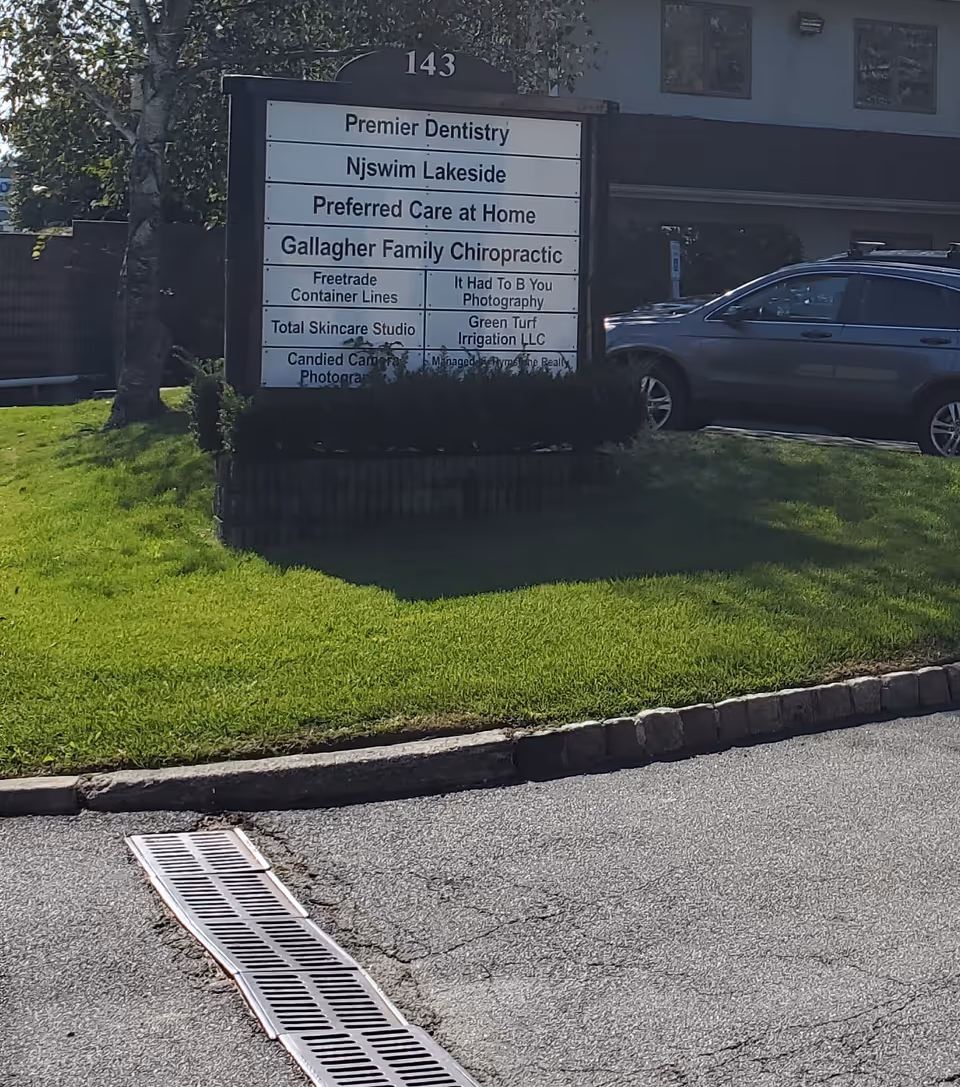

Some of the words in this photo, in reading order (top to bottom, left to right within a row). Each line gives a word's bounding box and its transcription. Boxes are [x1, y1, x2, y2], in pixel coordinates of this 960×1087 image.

[405, 51, 456, 76] 143
[346, 114, 419, 135] Premier
[426, 119, 509, 146] Dentistry
[347, 157, 415, 180] Njswim
[424, 161, 506, 183] Lakeside
[314, 196, 402, 217] Preferred
[410, 201, 452, 220] Care
[459, 204, 476, 221] at
[483, 204, 535, 223] Home
[282, 236, 376, 261] Gallagher
[383, 240, 444, 264] Family
[451, 242, 562, 266] Chiropractic
[314, 272, 377, 286] Freetrade
[455, 276, 462, 289] It
[468, 276, 492, 289] Had
[497, 277, 511, 290] To
[517, 278, 525, 290] B
[530, 278, 552, 291] You
[290, 289, 358, 304] Container
[363, 290, 397, 303] Lines
[463, 293, 544, 311] Photography
[272, 320, 303, 333] Total
[309, 321, 368, 335] Skincare
[373, 322, 415, 335] Studio
[469, 316, 507, 328] Green
[512, 316, 537, 328] Turf
[458, 333, 516, 348] Irrigation
[521, 333, 545, 346] LLC
[288, 352, 343, 365] Candied
[349, 353, 399, 367] Camra
[300, 370, 369, 386] Photogra
